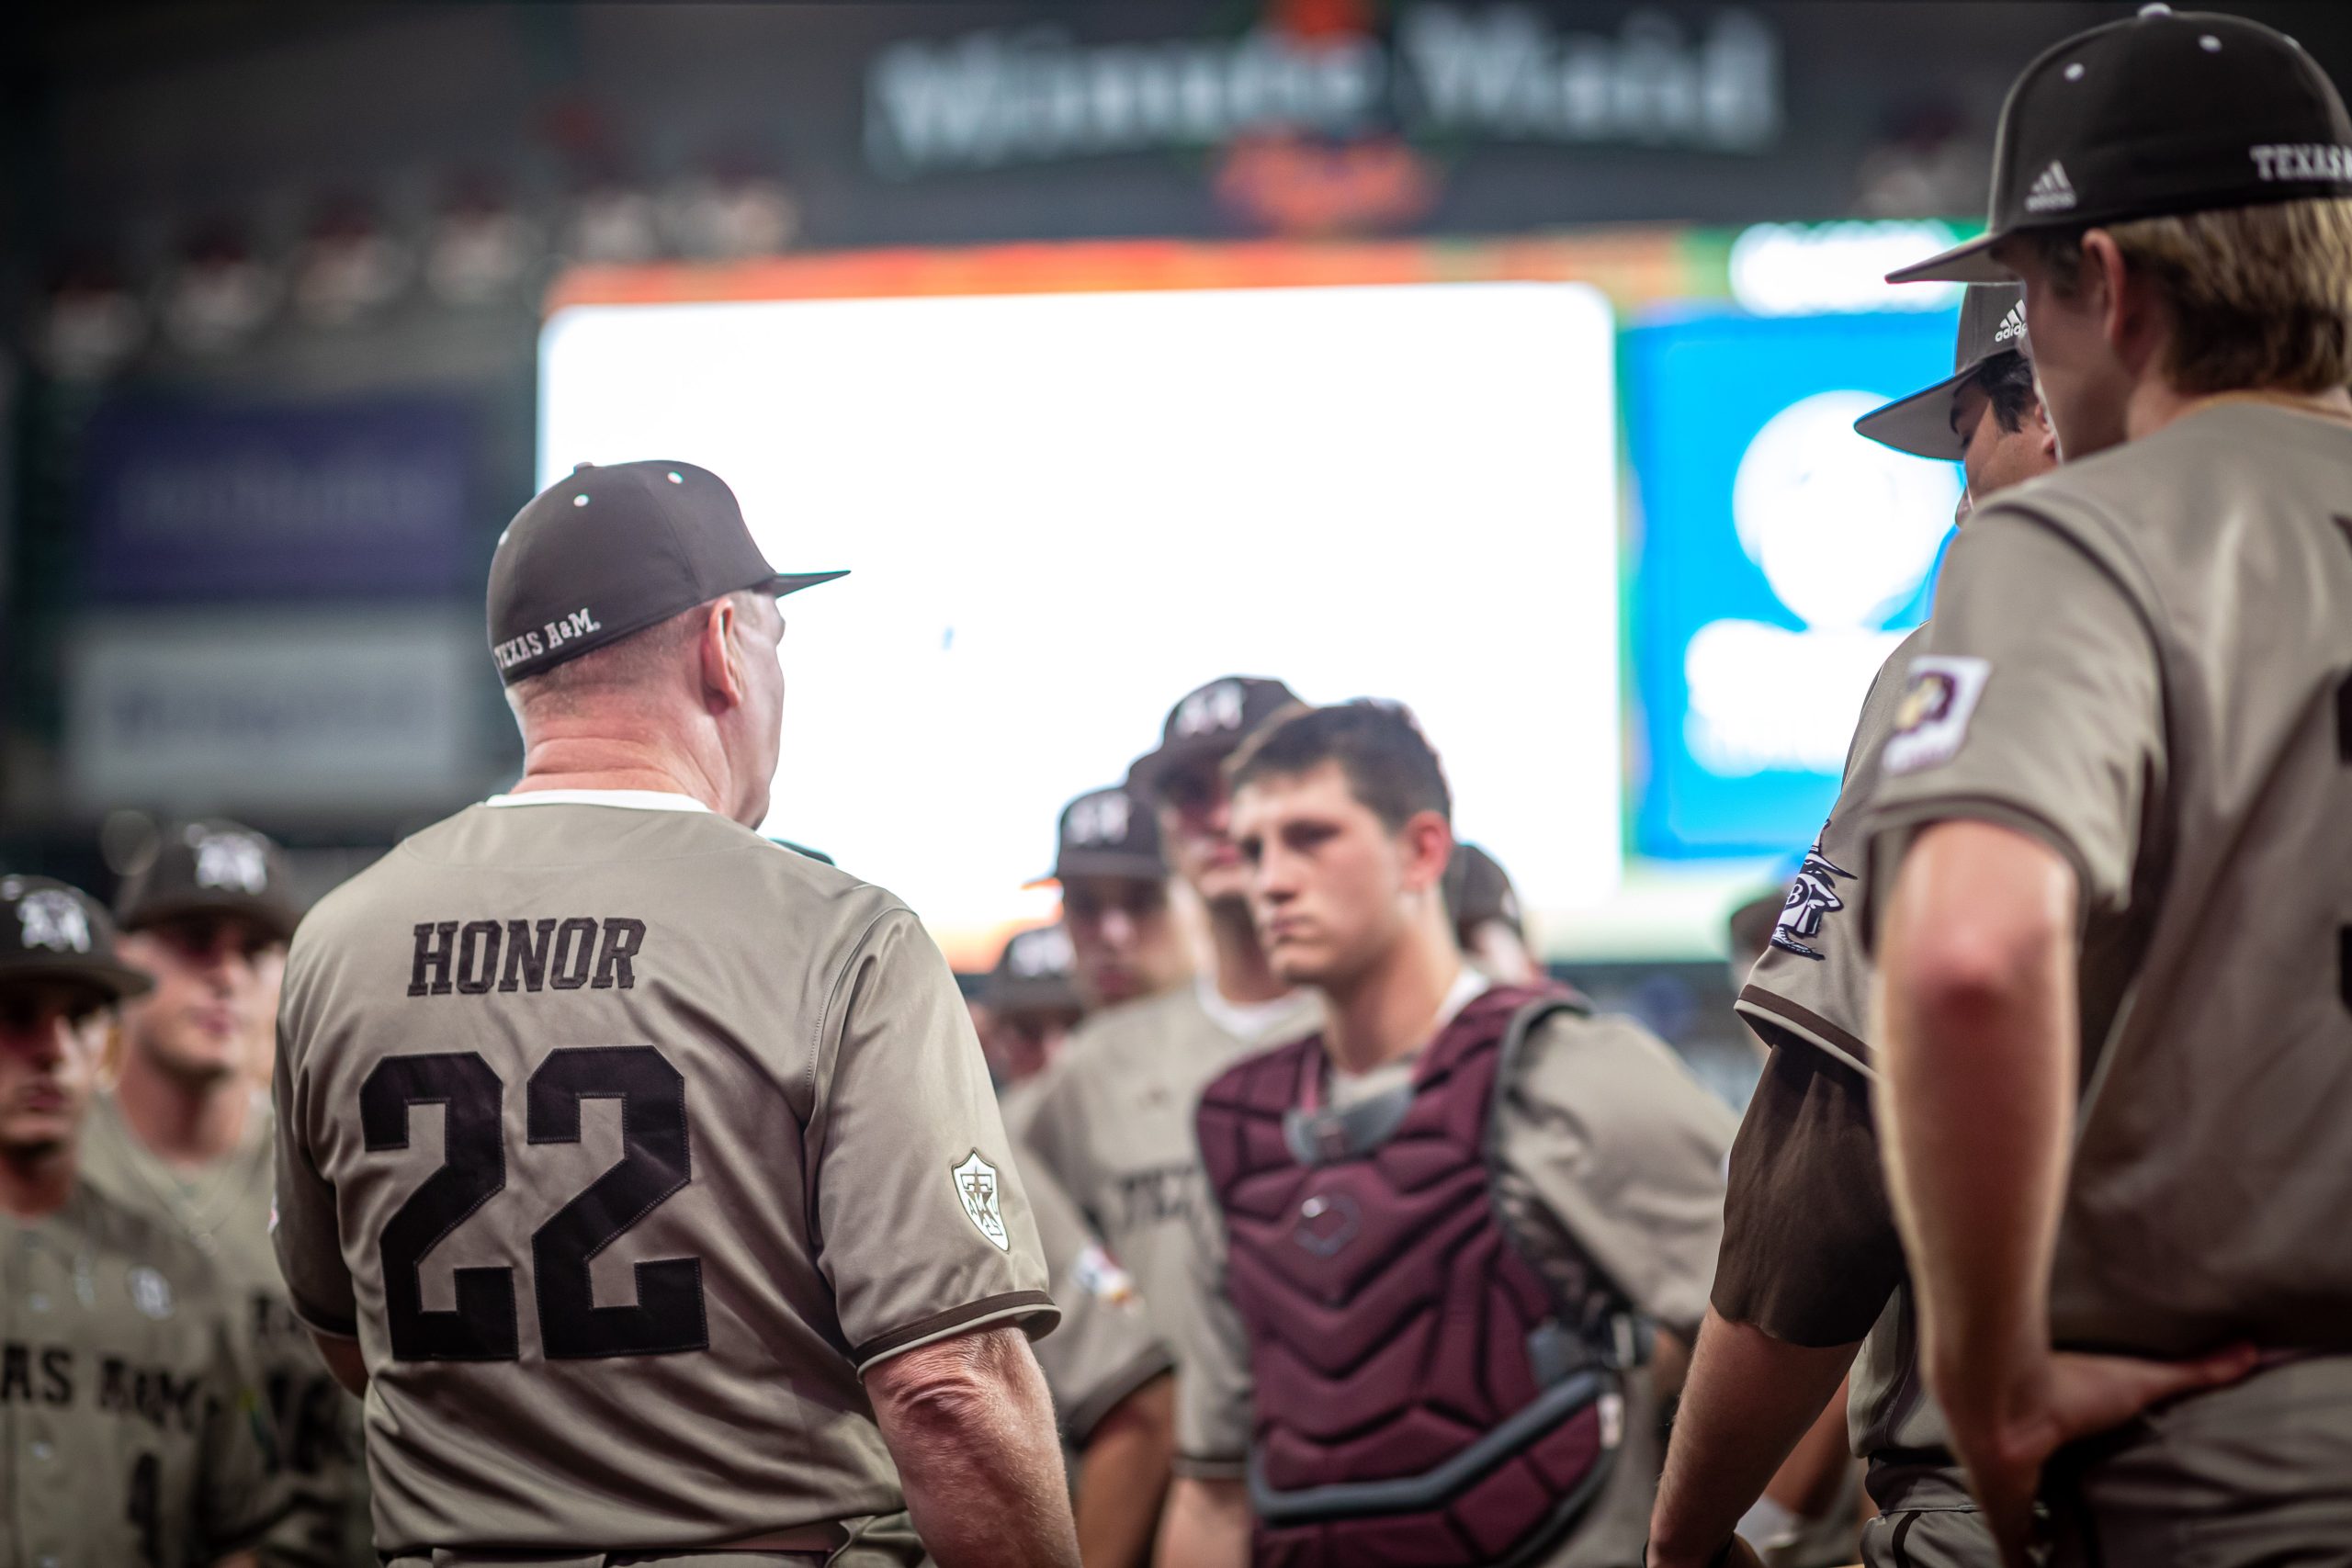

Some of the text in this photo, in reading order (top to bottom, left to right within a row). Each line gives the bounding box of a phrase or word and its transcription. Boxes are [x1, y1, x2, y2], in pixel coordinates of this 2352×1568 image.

[2249, 144, 2342, 181] TEXAS
[493, 631, 544, 670] TEXAS
[406, 917, 647, 997] HONOR
[359, 1044, 710, 1362] 22
